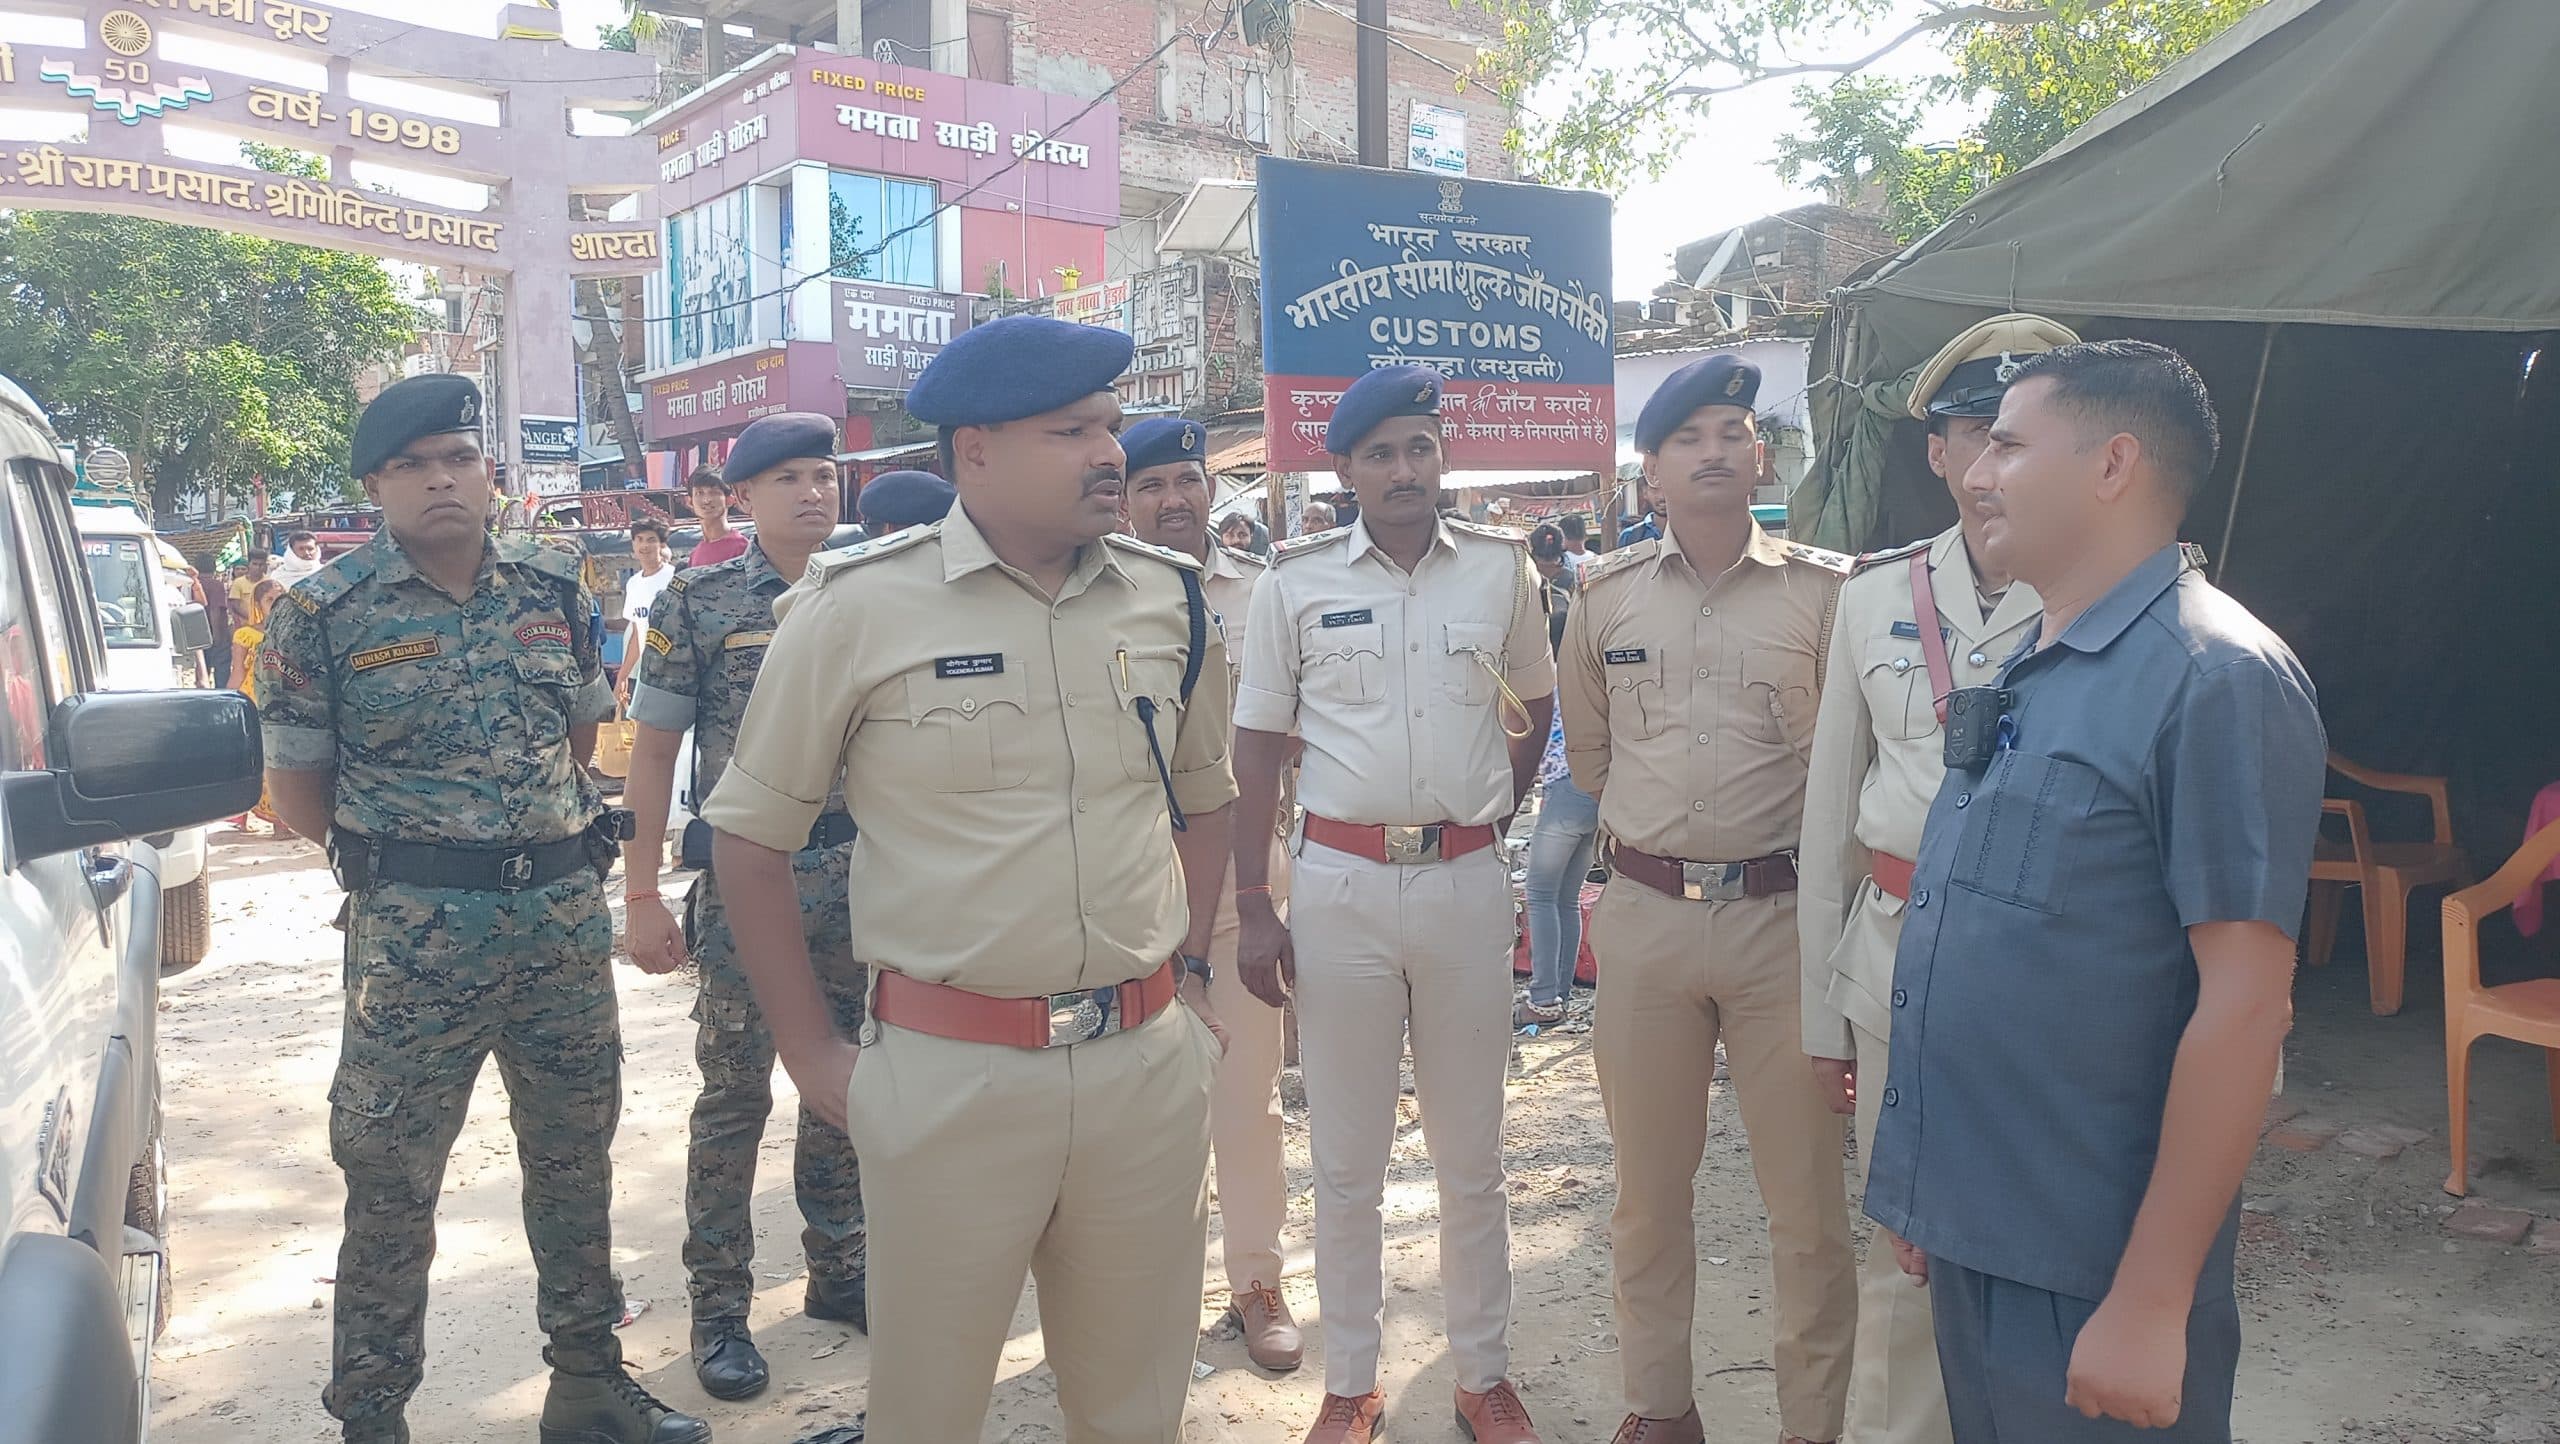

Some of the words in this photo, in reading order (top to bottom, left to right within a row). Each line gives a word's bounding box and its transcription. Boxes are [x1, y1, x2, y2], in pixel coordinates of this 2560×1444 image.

[263, 0, 333, 43] द्वार
[104, 58, 150, 84] 50
[811, 69, 866, 92] FIXED
[873, 79, 926, 102] PRICE
[345, 107, 462, 155] 1998
[834, 103, 921, 142] ममता
[933, 121, 999, 159] साड़ी
[660, 150, 695, 184] ममता
[67, 156, 142, 192] राम
[402, 205, 504, 253] प्रसाद
[571, 229, 658, 262] शारदा
[1367, 223, 1439, 252] भारत
[1451, 230, 1533, 259] सरकार
[908, 294, 932, 307] FIXED
[932, 299, 957, 310] PRICE
[1284, 258, 1393, 330] भारतीय
[1390, 248, 1454, 299] सीमा
[1454, 261, 1513, 311] शुल्क
[1558, 279, 1609, 348] चौकी
[843, 300, 957, 346] ममता
[1369, 316, 1543, 352] CUSTOMS
[864, 343, 899, 373] साड़ी
[667, 393, 698, 419] ममता
[701, 380, 727, 416] साड़ी
[524, 427, 566, 445] ANGEL
[1465, 413, 1508, 442] कैमरा
[1508, 416, 1525, 441] के
[1525, 418, 1580, 444] निगरानी
[1581, 417, 1593, 440] में
[520, 625, 568, 640] COMMANDO
[263, 651, 305, 686] COMMANDO
[354, 651, 392, 667] AVINASH
[392, 643, 427, 659] KUMAR
